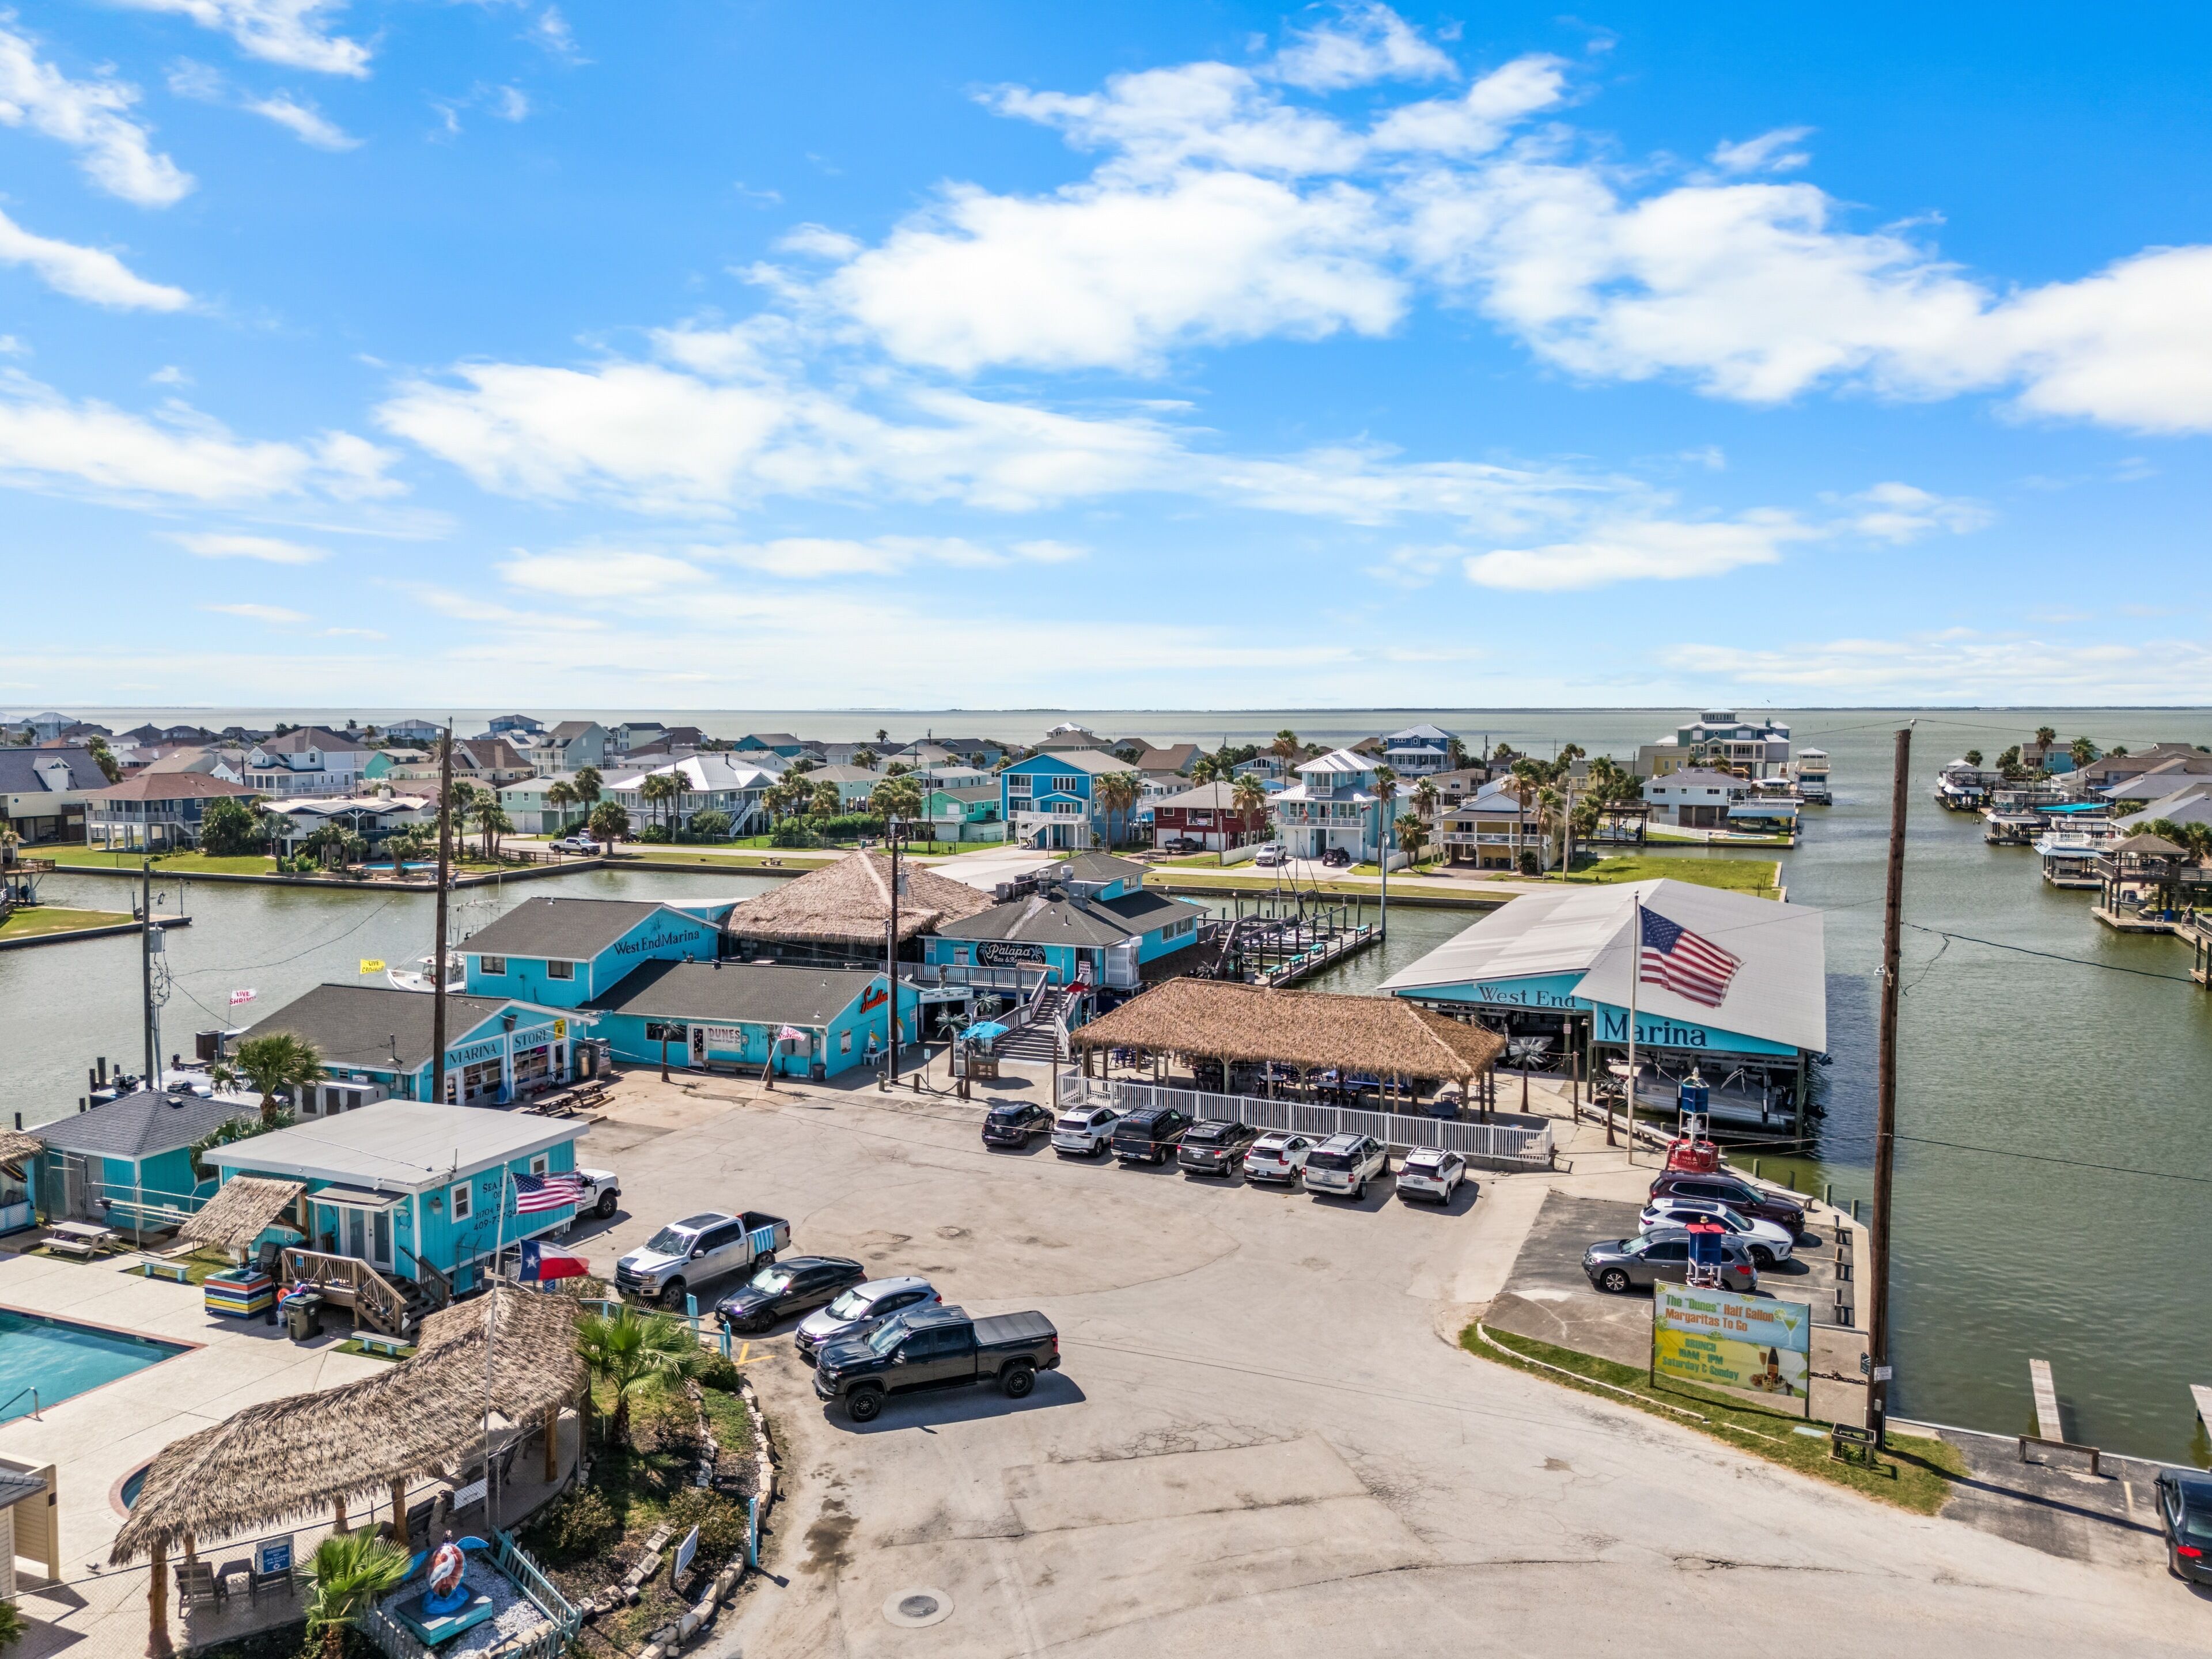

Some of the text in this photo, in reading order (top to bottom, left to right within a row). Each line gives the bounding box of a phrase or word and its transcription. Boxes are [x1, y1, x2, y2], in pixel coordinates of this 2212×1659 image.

[613, 930, 700, 956] West End Marina
[986, 944, 1031, 959] Palapa
[1009, 956, 1040, 964] Restaurant
[1478, 986, 1577, 1008] West End
[514, 1028, 550, 1048] STORE
[709, 1028, 741, 1039] DUNES
[1603, 1010, 1707, 1047] Marina
[449, 1043, 497, 1065] MARINA
[483, 1182, 498, 1194] SEA
[1666, 1294, 1683, 1307] The
[1724, 1304, 1743, 1317] Half
[1745, 1308, 1774, 1323] Gallon
[1665, 1308, 1748, 1332] Margaritas To Go
[1679, 1348, 1700, 1361] 10AM
[1685, 1338, 1716, 1353] BRUNCH
[1662, 1356, 1700, 1373] Saturday
[1710, 1365, 1739, 1381] Sunday
